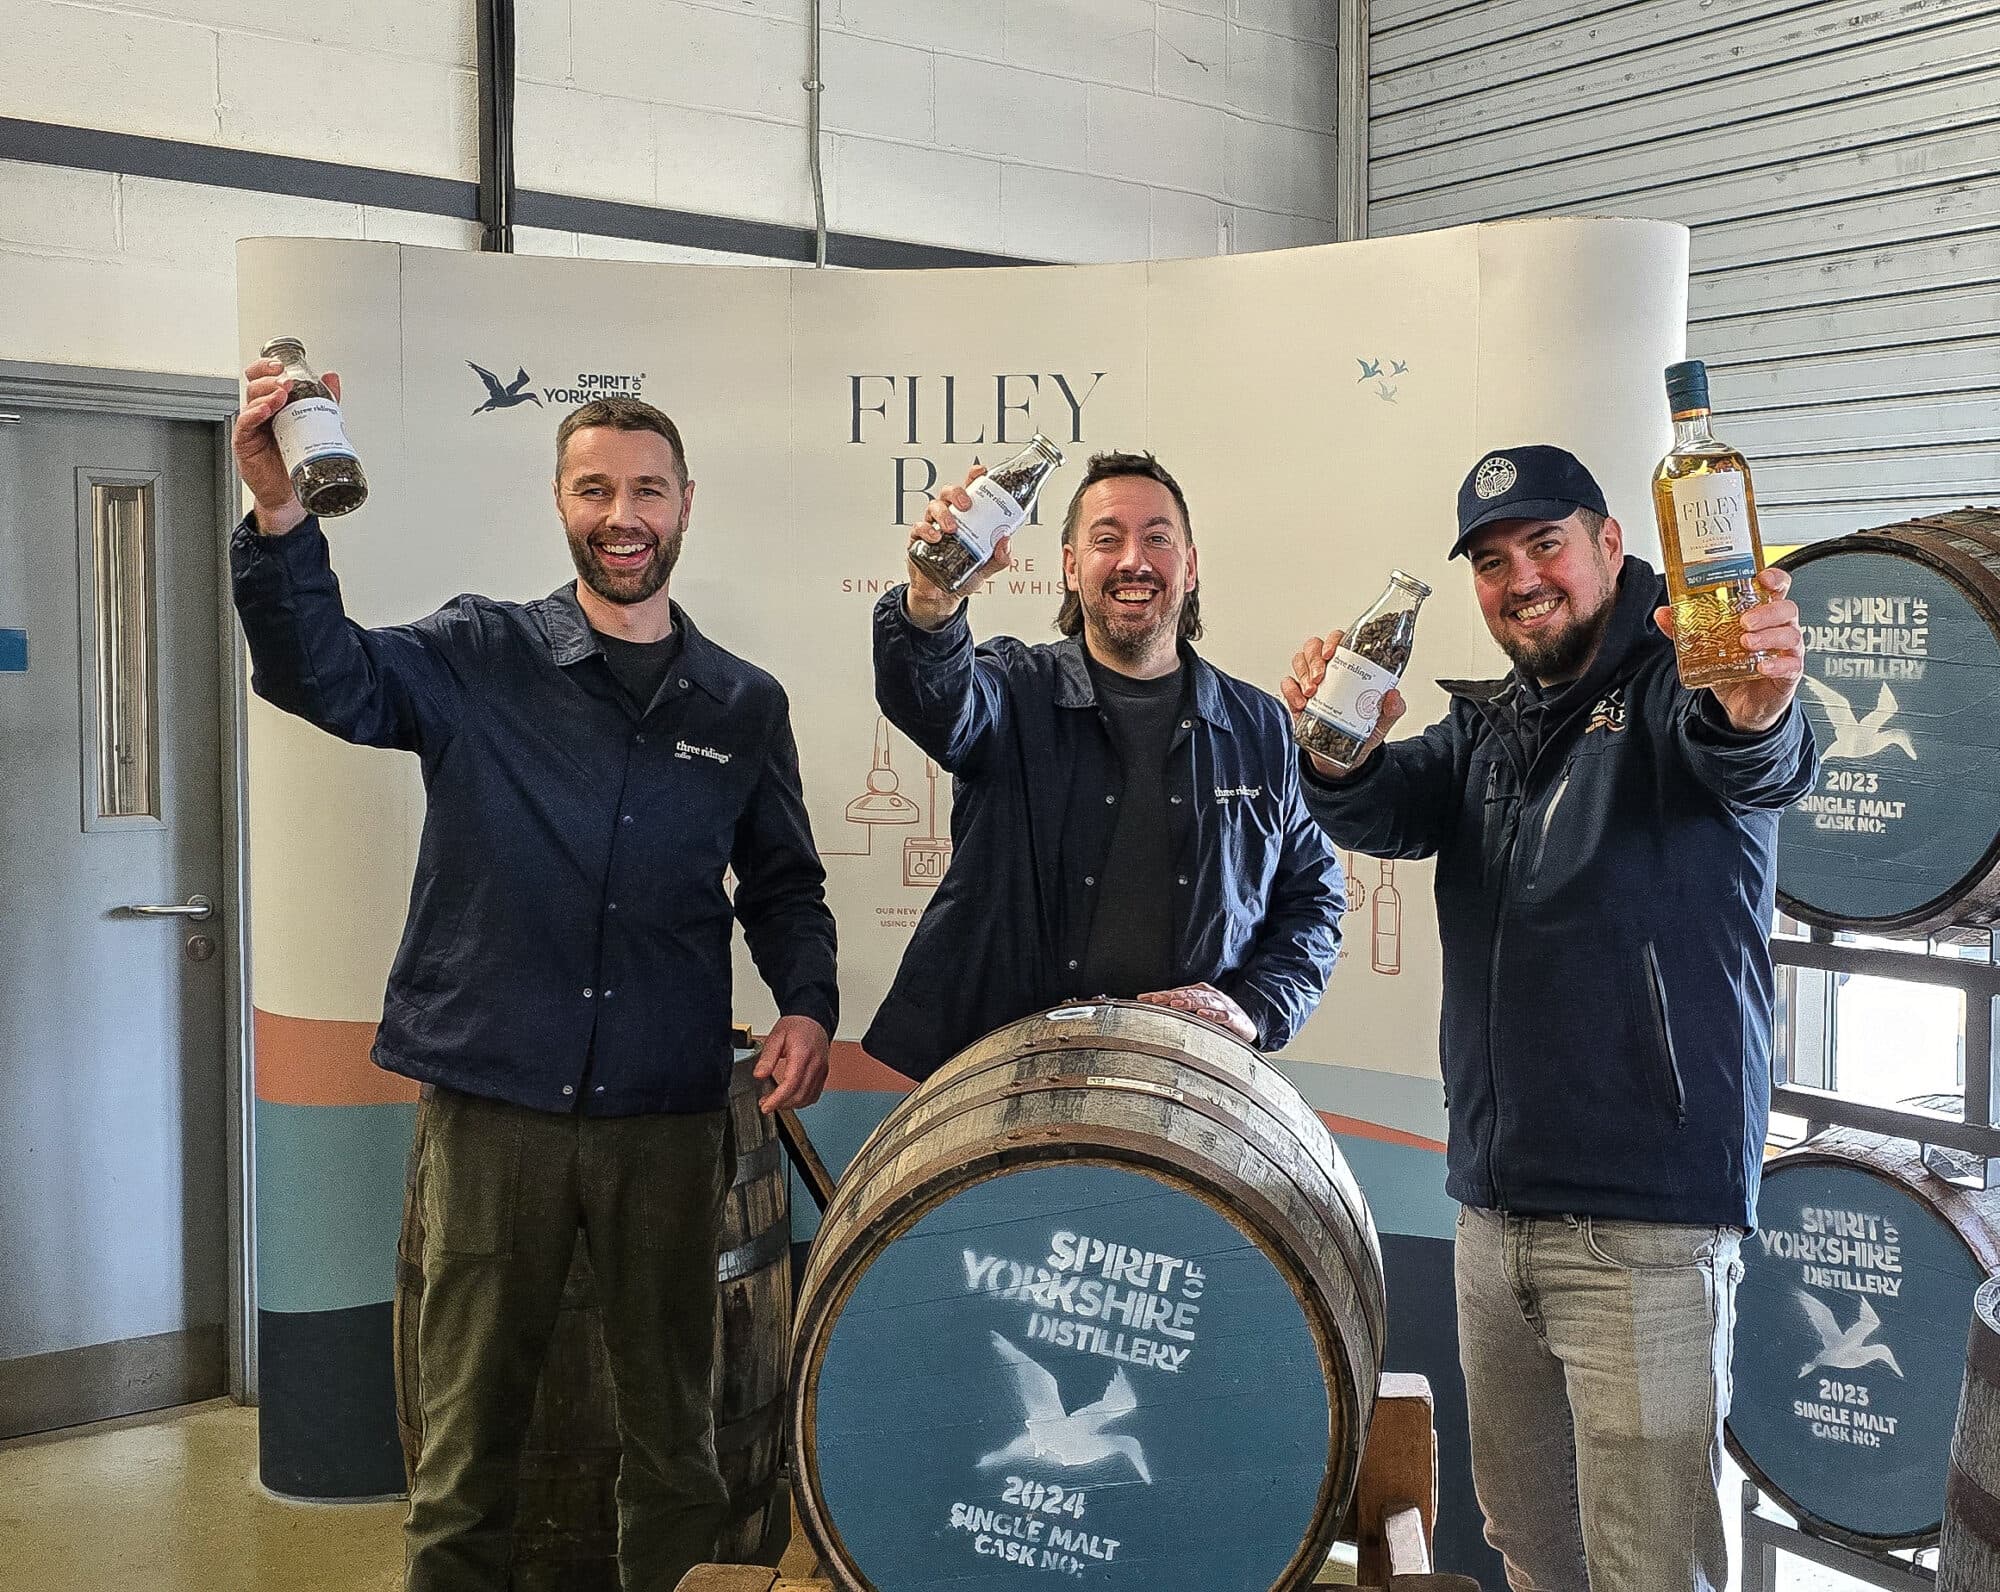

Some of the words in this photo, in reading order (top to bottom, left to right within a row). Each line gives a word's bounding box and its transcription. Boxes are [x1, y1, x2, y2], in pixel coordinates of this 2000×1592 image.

[577, 373, 630, 389] SPIRIT
[847, 372, 1107, 445] FILEY
[1682, 495, 1740, 521] FILEY
[1694, 515, 1734, 538] BAY
[1009, 580, 1066, 595] WHIS
[1828, 596, 1911, 625] SPIRIT
[1912, 597, 1929, 625] OF
[1801, 625, 1929, 656] ORKSHIRE
[1346, 662, 1373, 681] ridings
[1825, 656, 1926, 680] DISTILLERY
[676, 740, 700, 754] three
[701, 747, 729, 764] ridings
[1214, 786, 1235, 797] three
[1825, 770, 1879, 793] 2023
[1798, 795, 1856, 815] SINGLE
[1859, 799, 1906, 819] MALT
[1815, 814, 1856, 831] CASK
[1857, 816, 1888, 834] NO:
[875, 907, 895, 915] OUR
[1802, 1206, 1881, 1241] SPIRIT
[1048, 1230, 1184, 1292] SPIRIT
[1181, 1260, 1206, 1299] OF
[1758, 1228, 1903, 1273] YORKSHIRE
[1802, 1264, 1903, 1297] DISTILLERY
[963, 1249, 1201, 1341] YORKSHIRE
[1027, 1312, 1191, 1373] DISTILLERY
[1818, 1379, 1870, 1407] 2023
[1793, 1400, 1851, 1426] SINGLE
[1852, 1411, 1898, 1435] MALT
[1811, 1421, 1851, 1443] CASK
[1852, 1429, 1881, 1448] NO:
[1001, 1475, 1086, 1519] 2024
[950, 1502, 1045, 1543] SINGLE
[1047, 1525, 1121, 1562] MALT
[974, 1533, 1037, 1568] CASK
